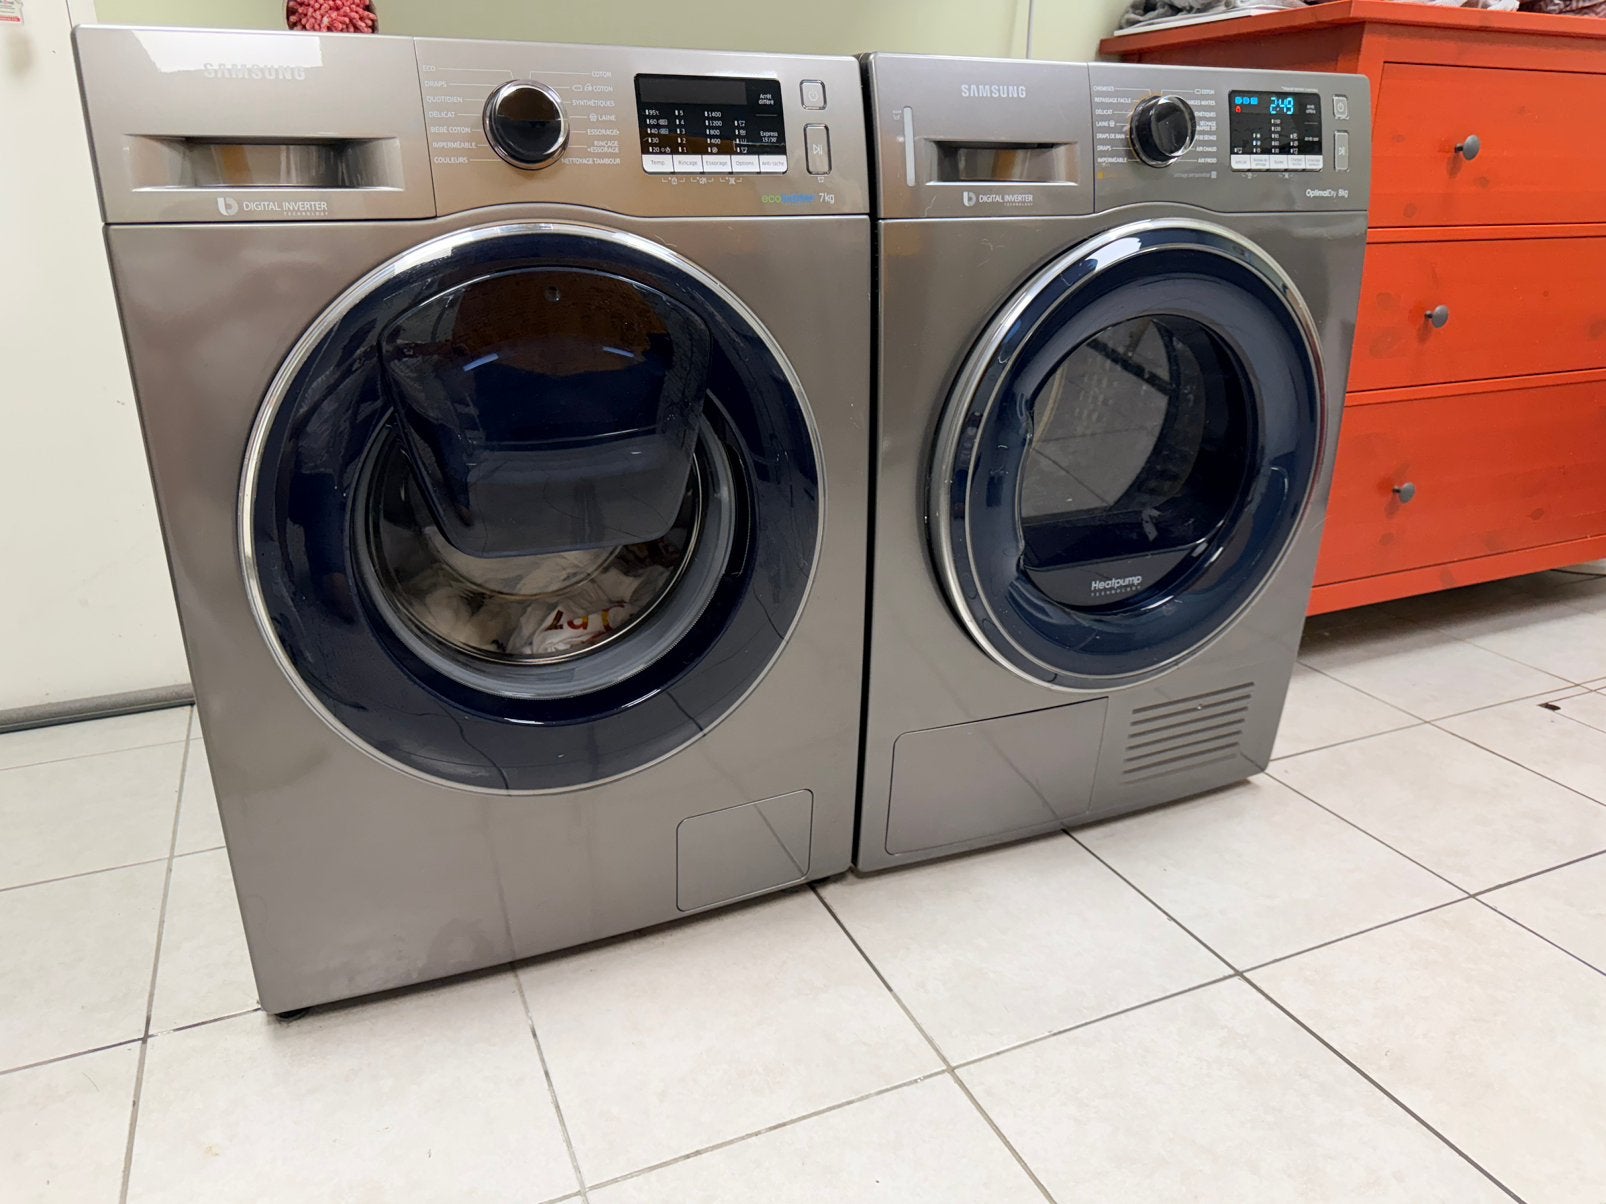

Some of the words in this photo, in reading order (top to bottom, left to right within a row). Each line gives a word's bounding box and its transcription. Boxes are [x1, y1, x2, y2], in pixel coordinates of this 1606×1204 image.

[203, 63, 306, 80] SAMSUNG
[422, 64, 436, 72] ECO
[424, 80, 447, 88] DRAPS
[961, 84, 1027, 98] SAMSUNG
[426, 95, 463, 103] QUOTIDIEN
[1269, 97, 1294, 114] 2:49
[598, 114, 617, 122] LAINE
[449, 126, 471, 134] COTON
[433, 156, 469, 164] COULEURS
[594, 157, 621, 165] TAMBOUR
[818, 192, 835, 204] 7kg
[1305, 188, 1337, 199] OptimalDry
[979, 194, 1003, 203] DIGITAL
[1004, 194, 1033, 202] INVERTER
[243, 201, 281, 211] DIGITAL
[283, 201, 328, 211] INVERTER
[1091, 575, 1143, 591] Heatpump
